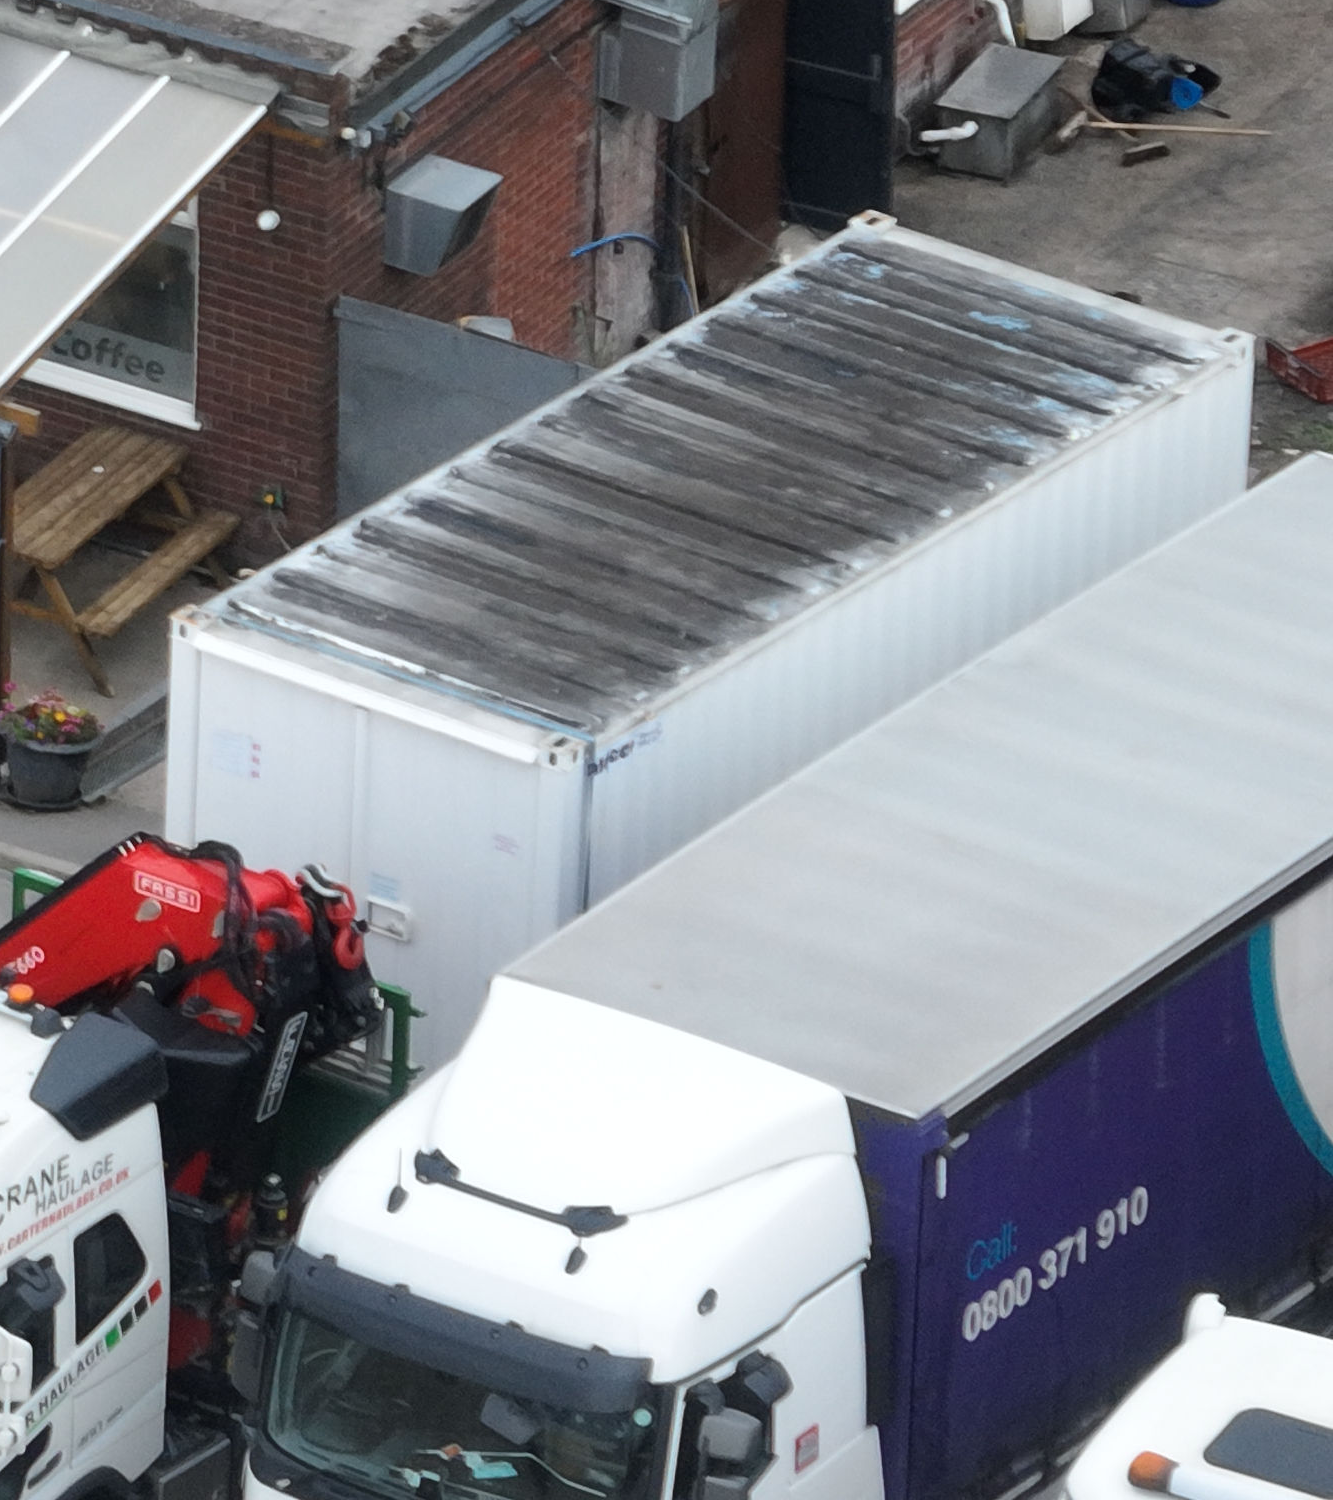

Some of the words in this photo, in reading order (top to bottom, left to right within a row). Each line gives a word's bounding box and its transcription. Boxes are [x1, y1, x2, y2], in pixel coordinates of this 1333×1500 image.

[140, 876, 195, 908] FASSI
[35, 1152, 115, 1217] HAULAGE
[961, 1265, 1034, 1343] 0800
[1037, 1225, 1088, 1291] 371
[1095, 1185, 1150, 1251] 910
[965, 1220, 1019, 1281] Call:
[38, 1340, 107, 1417] HAULAGE
